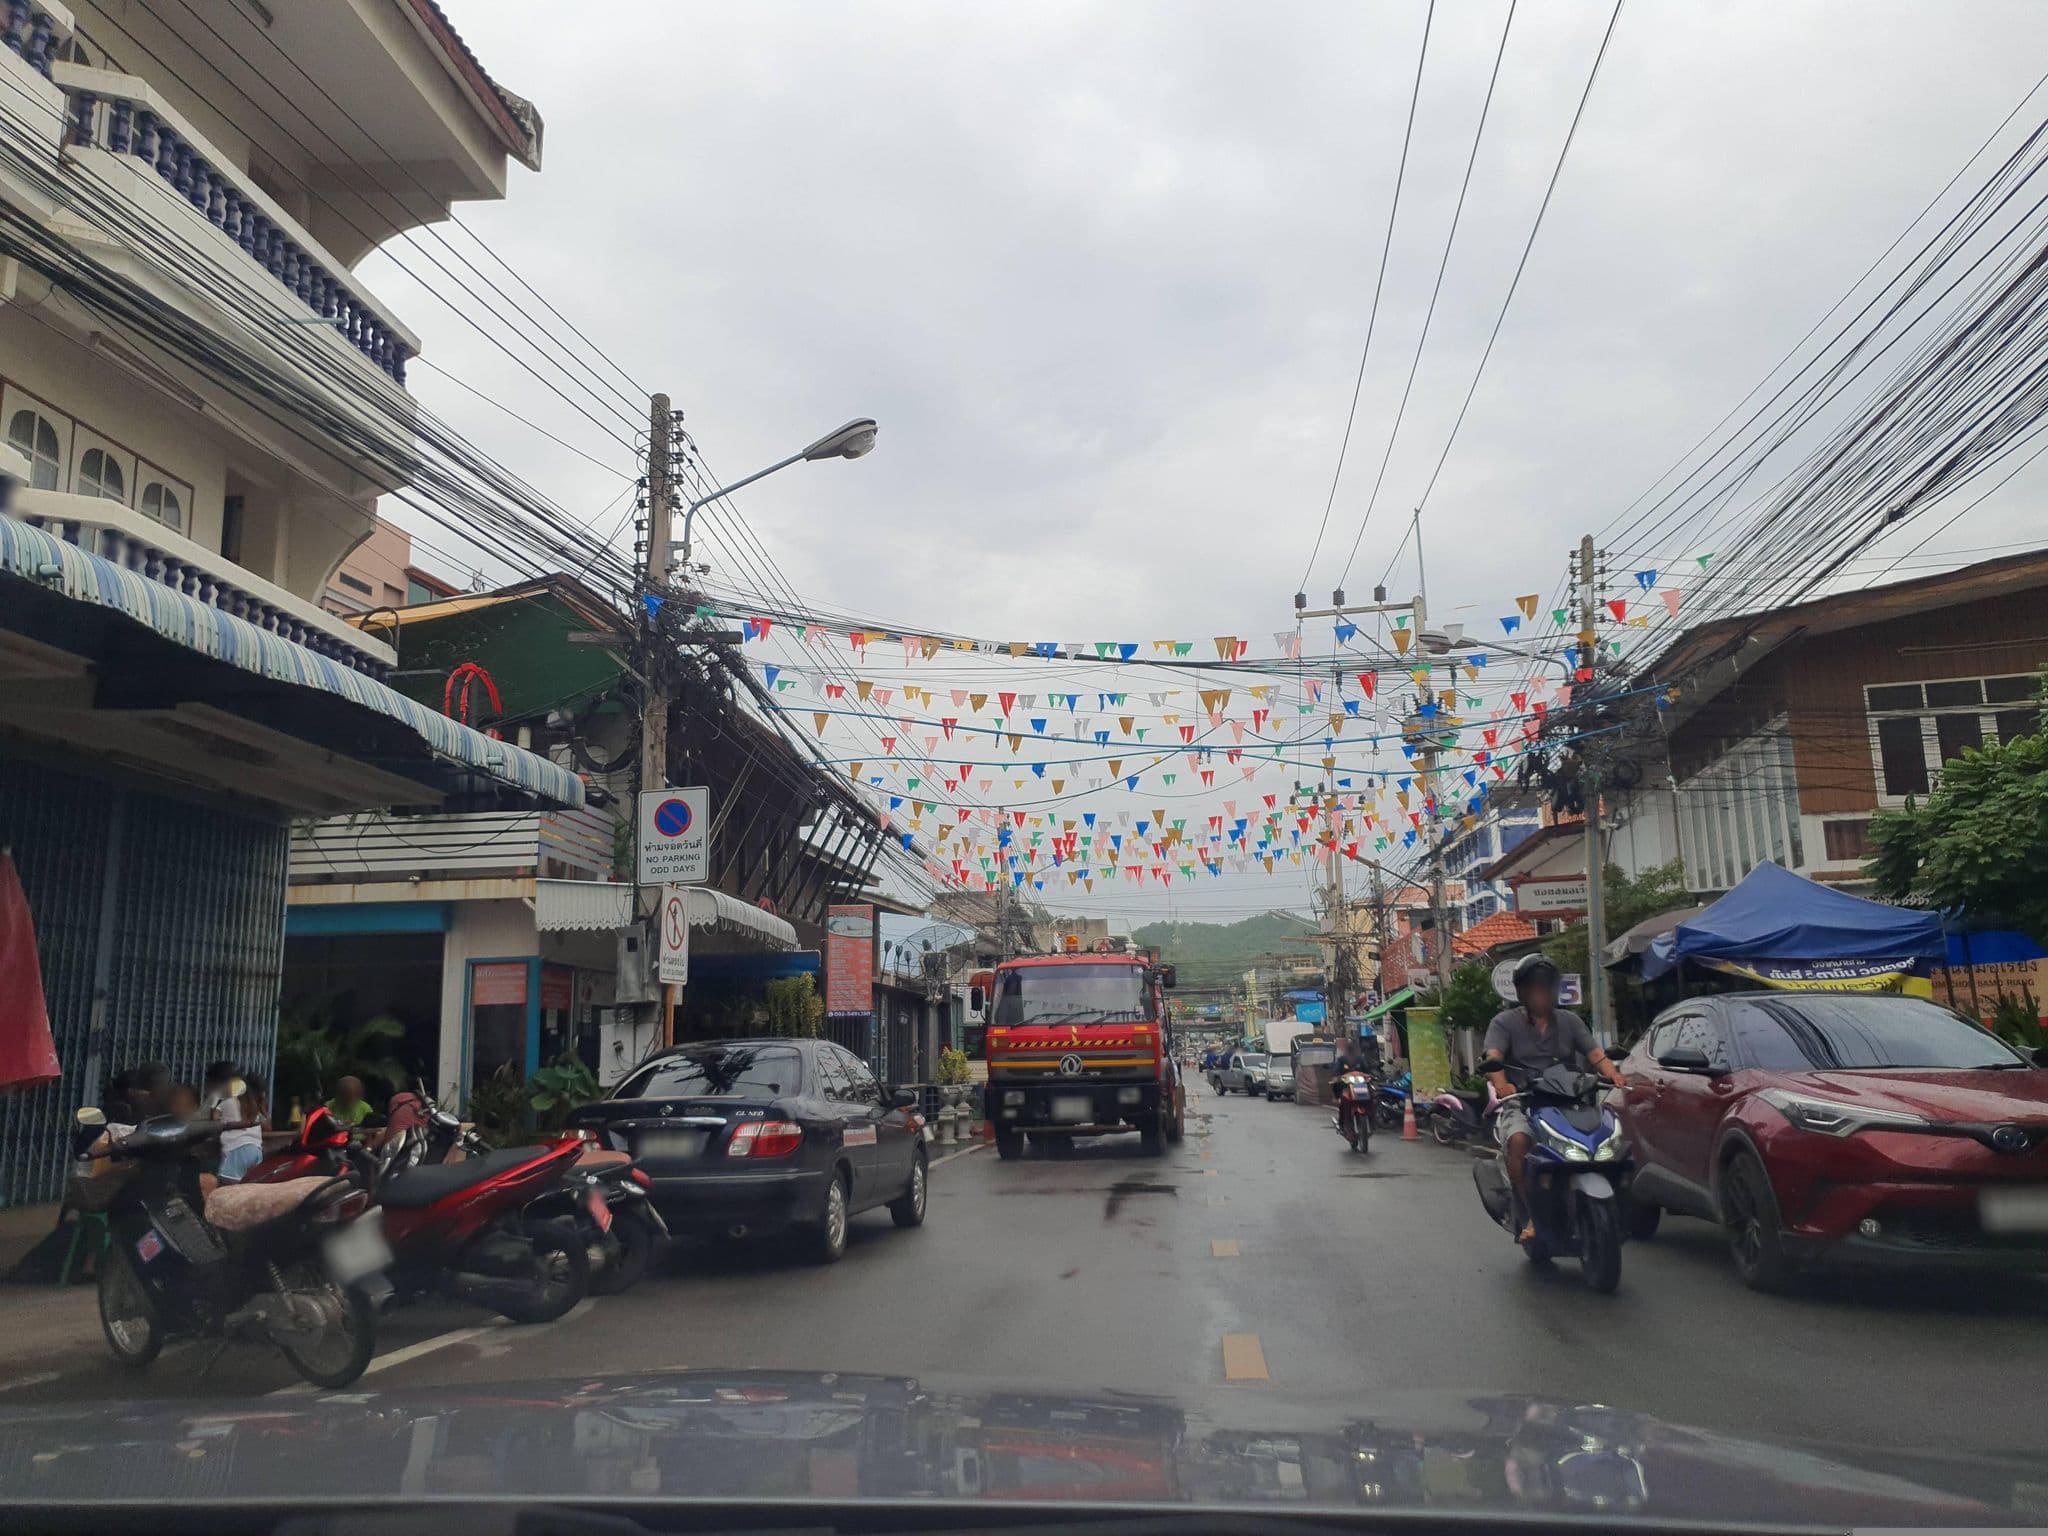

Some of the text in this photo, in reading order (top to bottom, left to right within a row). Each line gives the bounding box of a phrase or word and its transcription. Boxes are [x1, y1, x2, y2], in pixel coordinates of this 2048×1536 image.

[644, 836, 703, 852] ห้ามจอดวันคี่
[646, 853, 701, 864] NO PARKING
[650, 864, 696, 874] ODD DAYS
[1559, 980, 1580, 1004] 5
